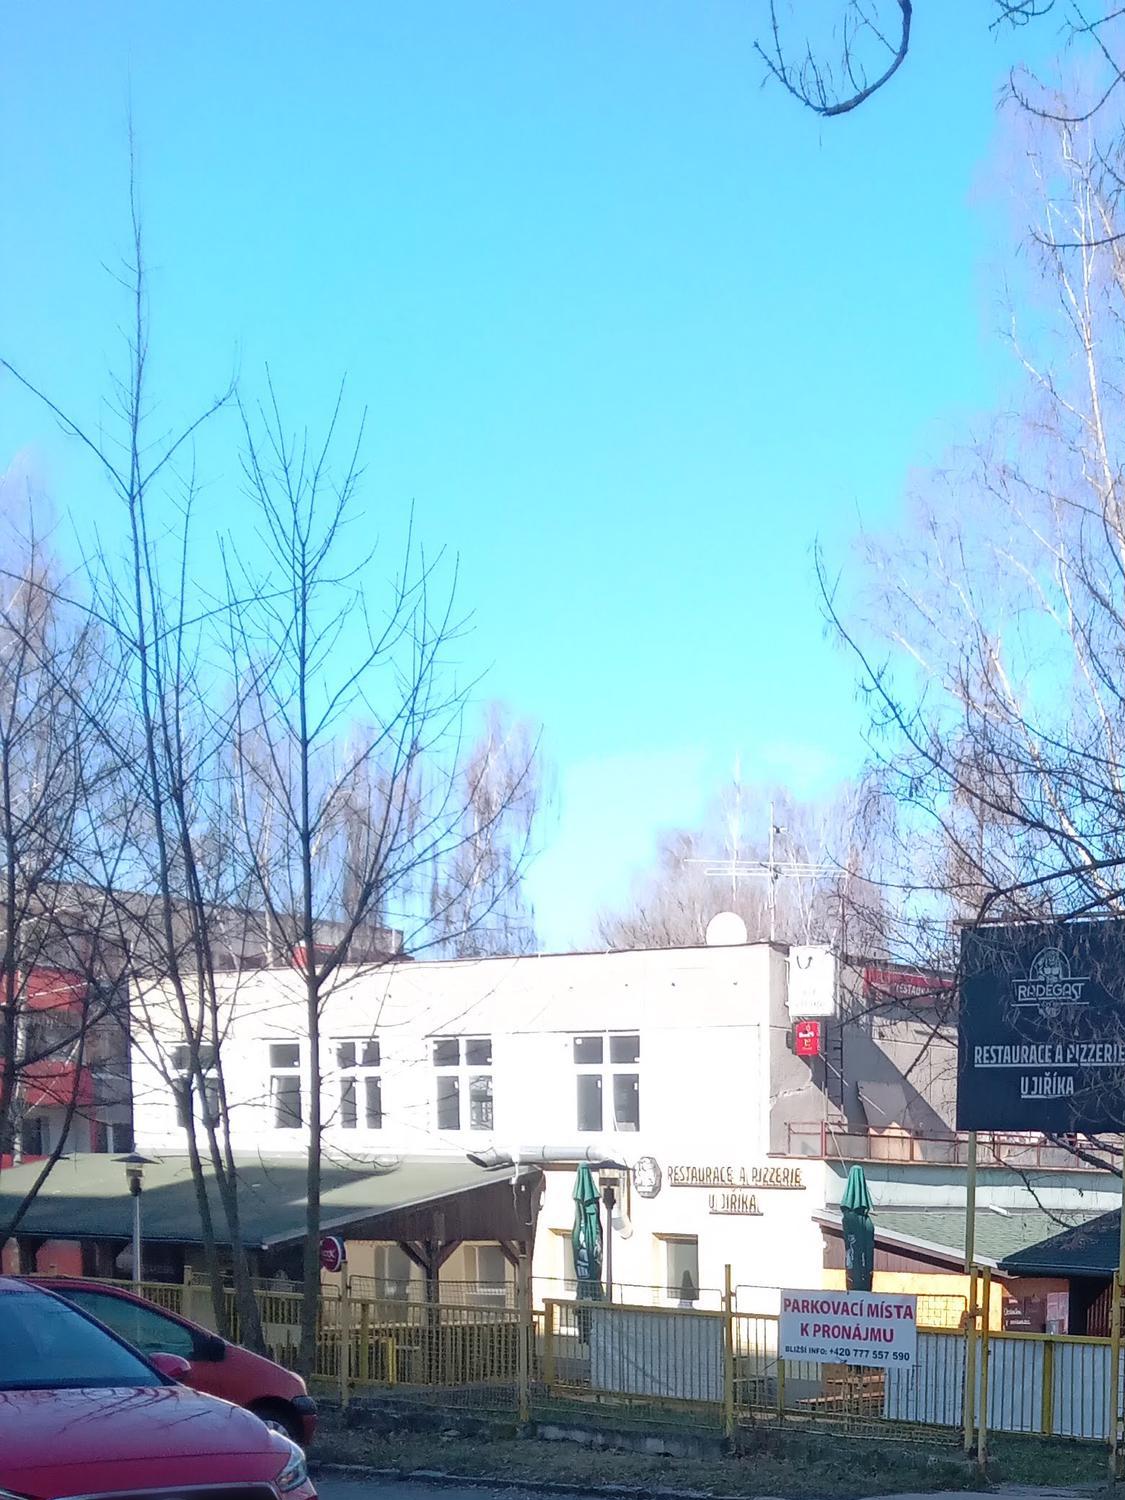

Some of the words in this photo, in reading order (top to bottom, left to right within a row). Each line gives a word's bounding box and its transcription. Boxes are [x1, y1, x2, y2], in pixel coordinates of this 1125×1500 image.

[1018, 982, 1085, 1002] RADEGAST
[974, 1045, 1052, 1064] RESTAURACE
[1055, 1044, 1063, 1063] A
[1066, 1044, 1125, 1063] PIZZERIE
[1020, 1076, 1029, 1095] U
[1031, 1072, 1074, 1095] JIŘÍKA
[668, 1165, 732, 1182] RESTAURACE
[740, 1167, 747, 1185] A
[752, 1167, 802, 1185] PIZZERIE
[709, 1194, 715, 1209] U
[784, 1298, 864, 1317] PARKOVACÍ
[867, 1301, 913, 1320] MÍSTA
[801, 1323, 809, 1337] K
[813, 1323, 894, 1343] PRONÁJMU
[809, 1348, 827, 1356] INFO:
[829, 1347, 850, 1357] +420
[853, 1348, 869, 1359] 777
[872, 1351, 889, 1361] 557
[892, 1351, 910, 1361] 590
